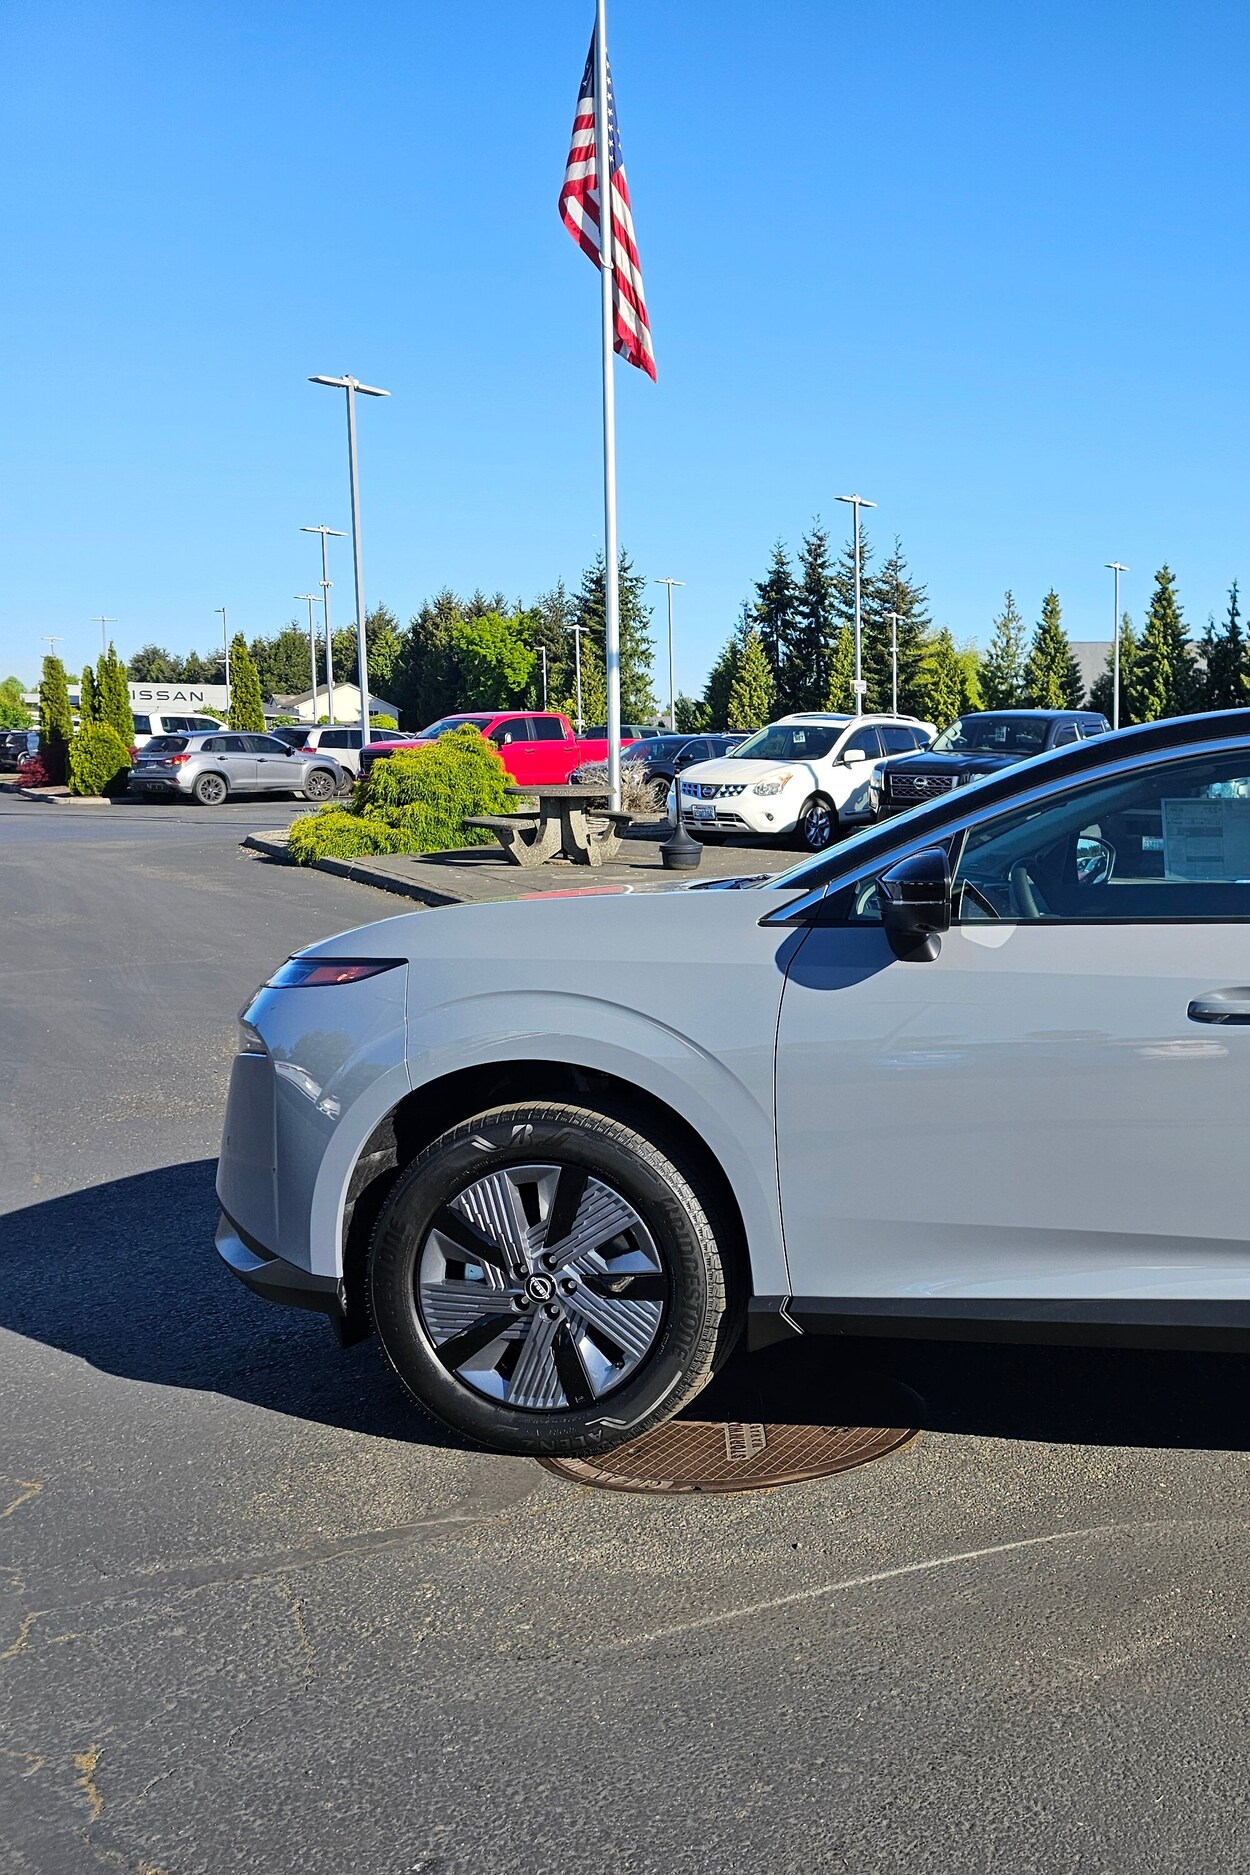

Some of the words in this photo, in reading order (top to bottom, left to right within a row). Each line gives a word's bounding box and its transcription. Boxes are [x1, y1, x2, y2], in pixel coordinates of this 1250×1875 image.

[132, 690, 204, 702] ISSAN
[659, 1196, 704, 1363] BRIDGESTONE
[508, 1429, 603, 1451] ALENZ
